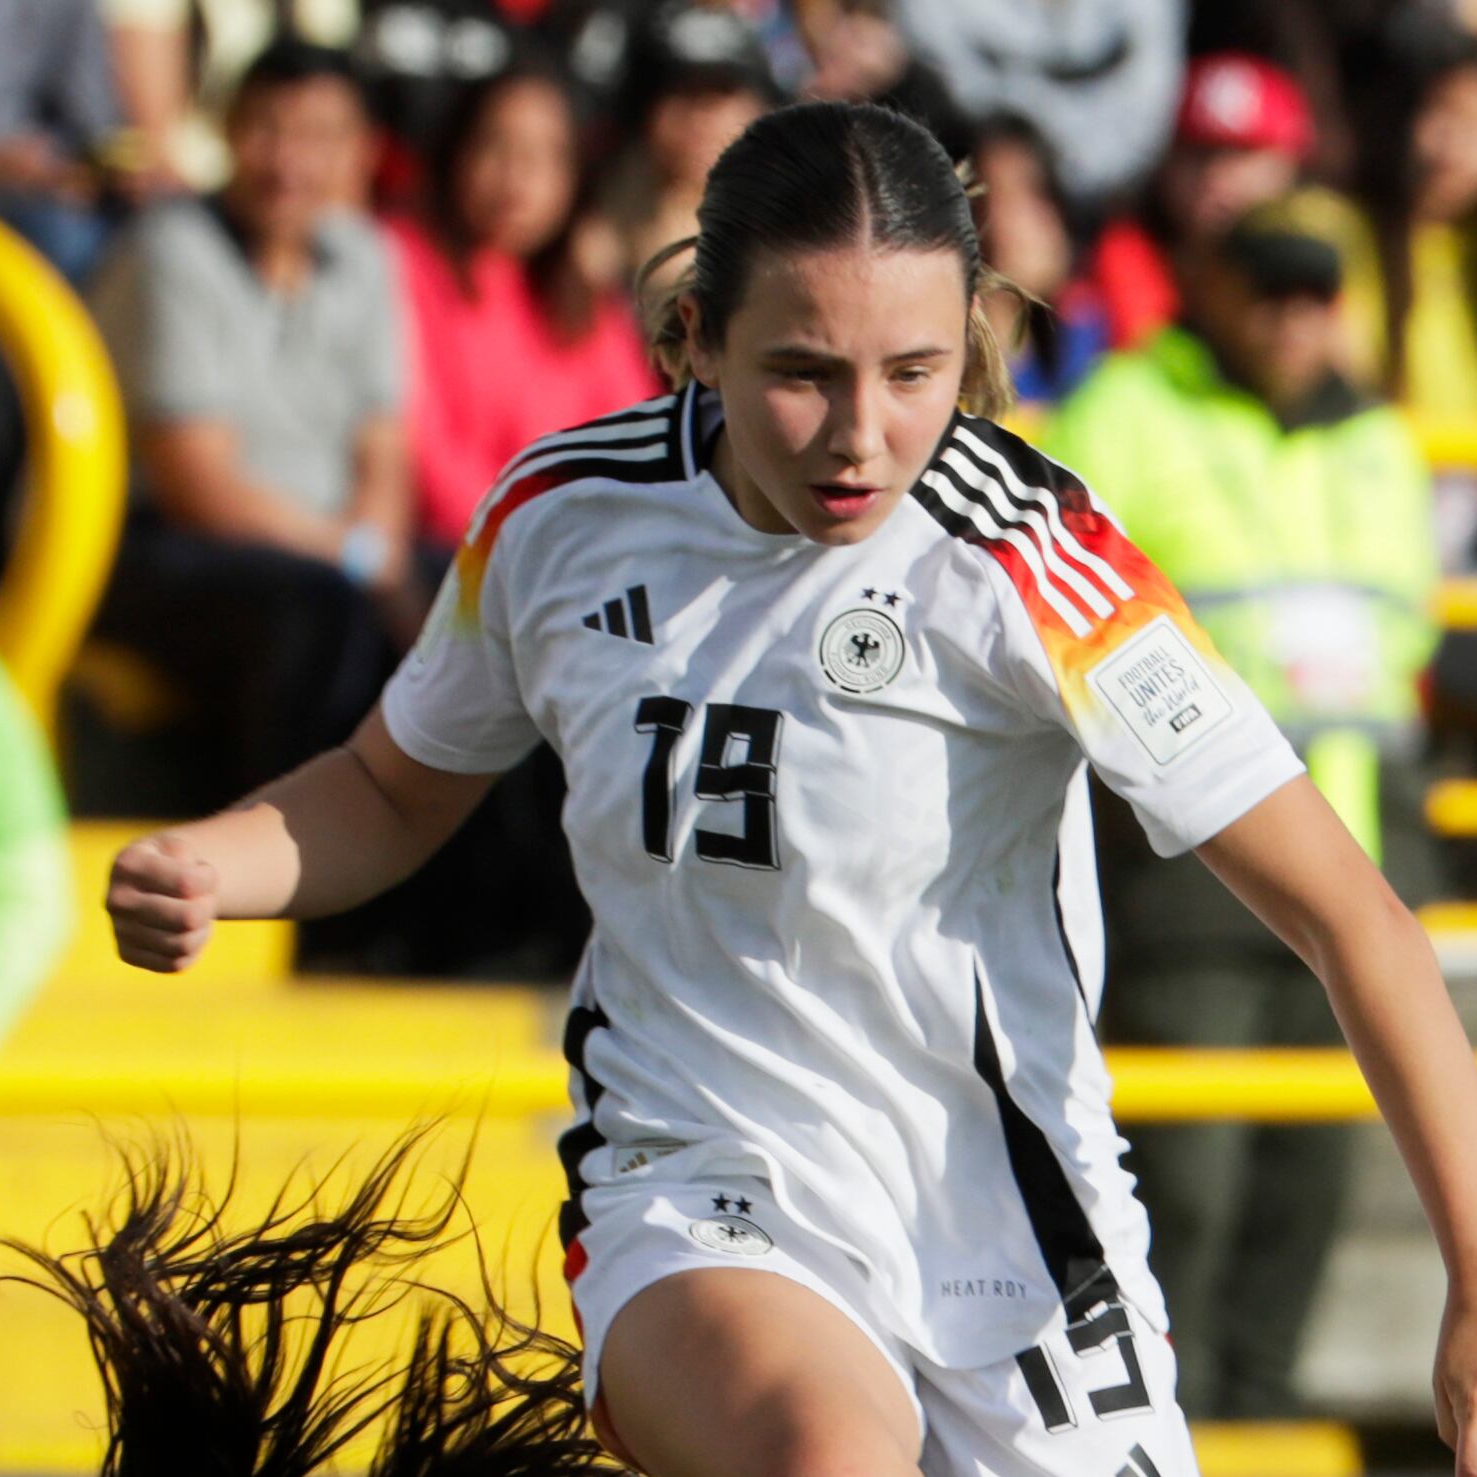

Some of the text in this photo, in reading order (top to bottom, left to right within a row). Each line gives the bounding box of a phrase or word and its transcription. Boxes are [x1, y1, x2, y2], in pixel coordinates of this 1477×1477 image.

[1117, 646, 1170, 690] FOOTBALL
[1129, 658, 1185, 708] UNITES
[634, 695, 785, 871] 19
